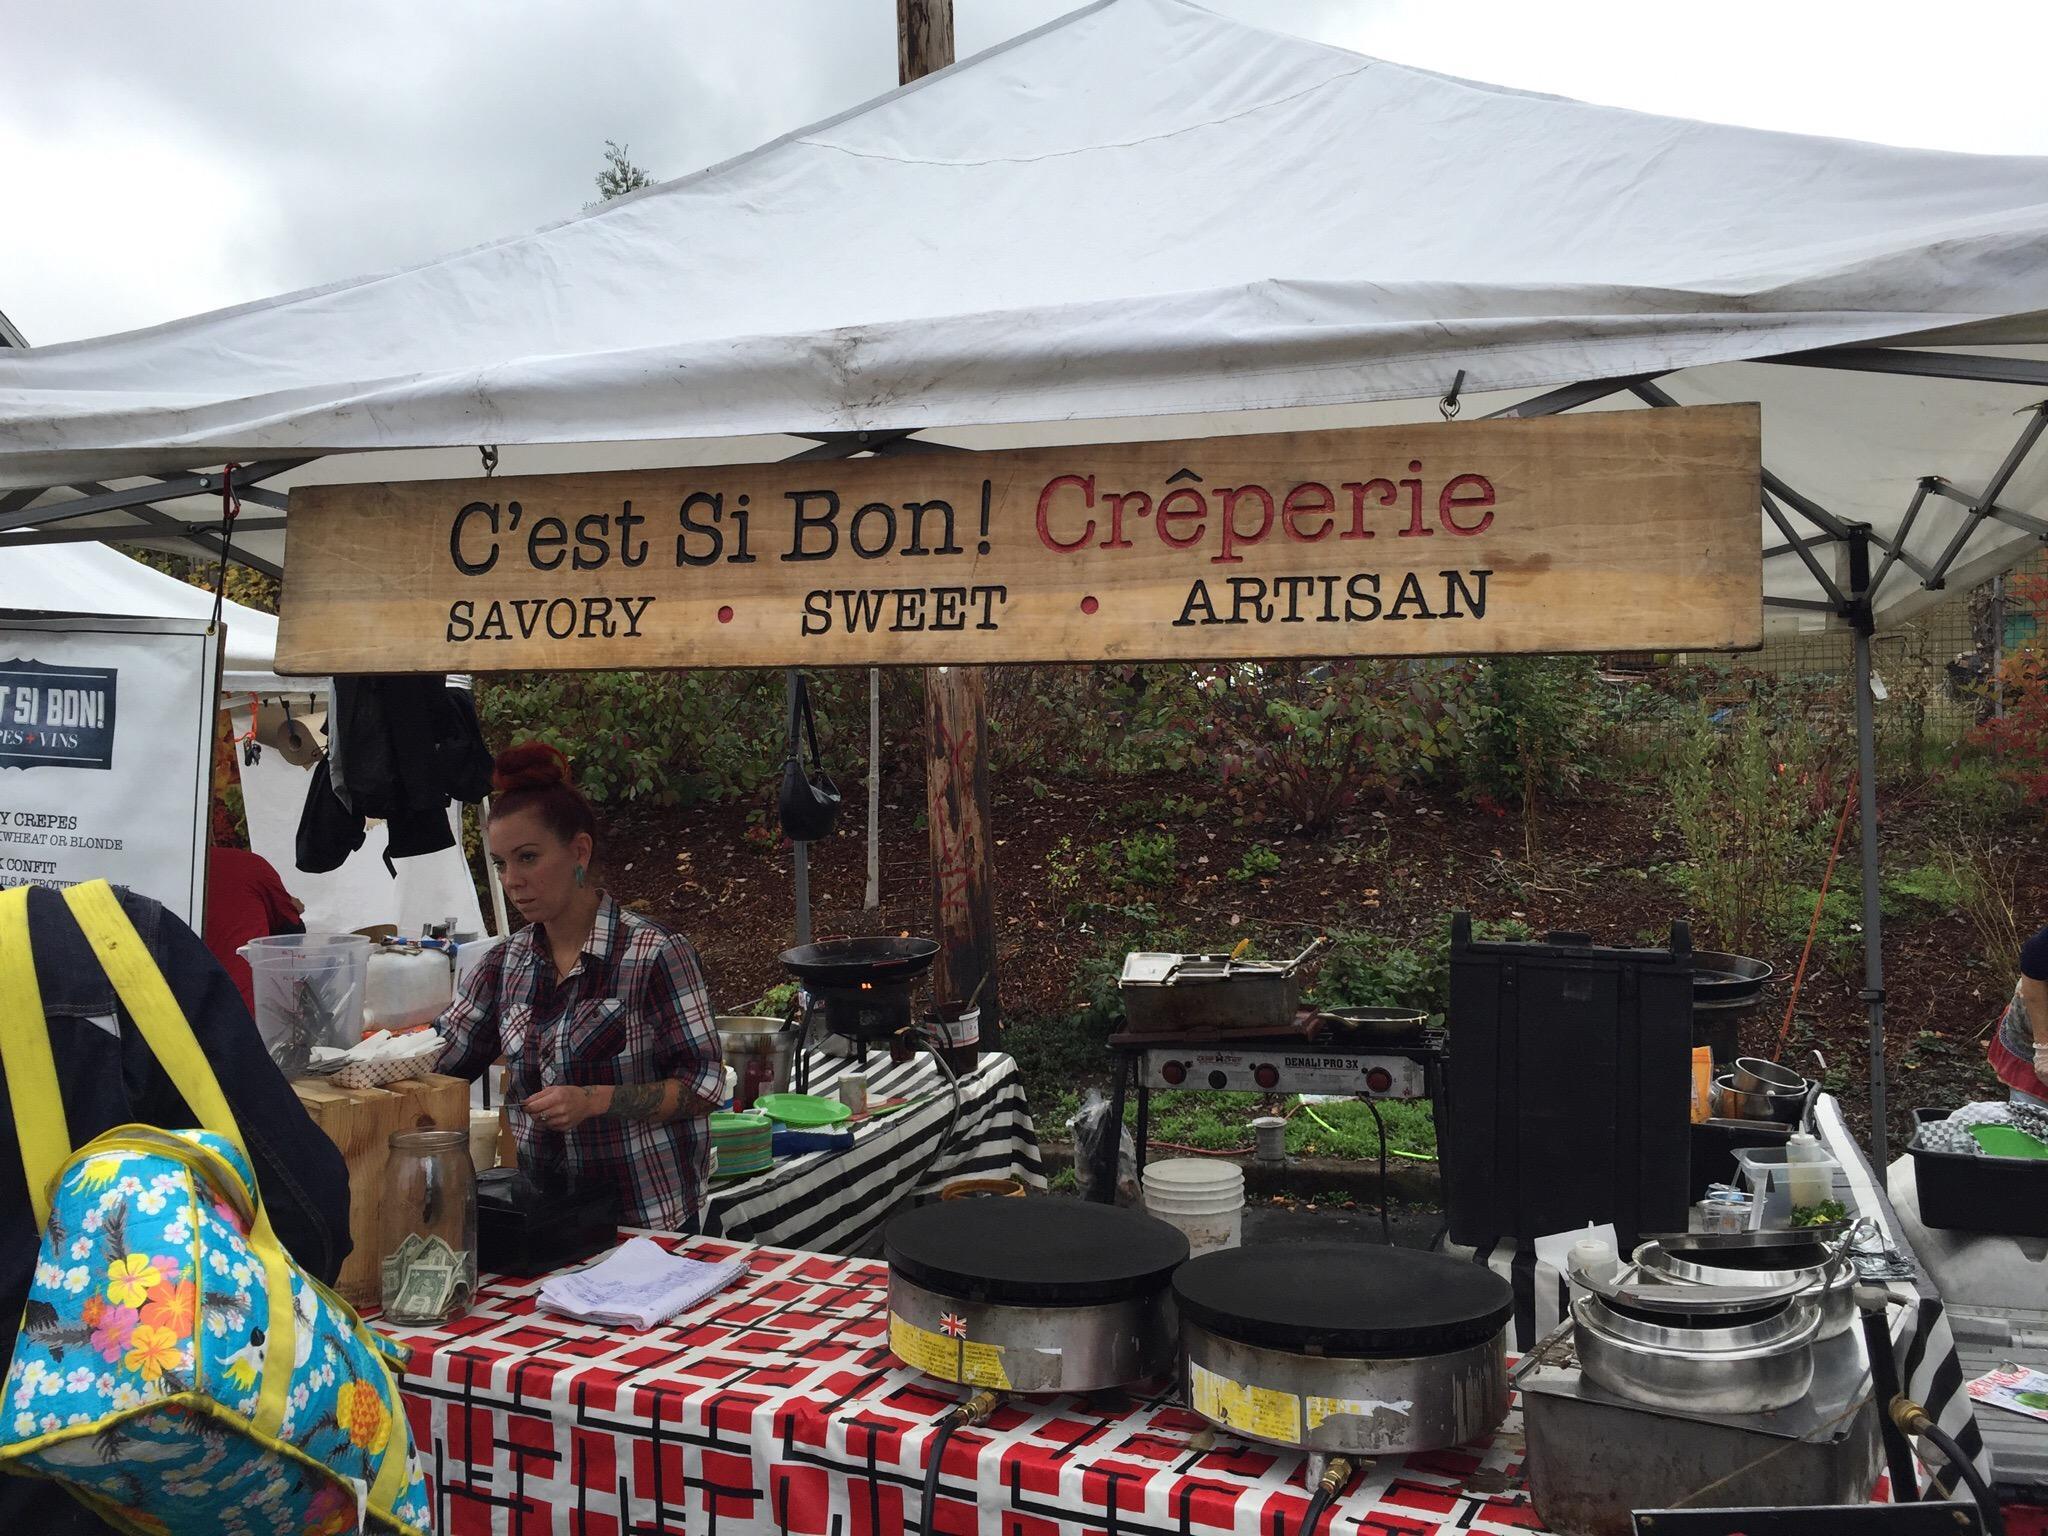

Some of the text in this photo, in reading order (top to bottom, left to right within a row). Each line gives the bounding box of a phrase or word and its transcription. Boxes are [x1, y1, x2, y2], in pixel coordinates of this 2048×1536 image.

[449, 460, 1496, 576] C'est Si Bon! Crêperie
[446, 570, 1493, 643] SAVORY SWEET ARTISAN
[14, 687, 39, 725] SI
[46, 688, 104, 728] BON!
[40, 732, 78, 748] VINS
[14, 812, 77, 830] CREPES
[50, 835, 68, 847] OR
[70, 836, 123, 850] BLONDE
[6, 858, 57, 874] CONFIT
[1284, 1056, 1359, 1069] DENALI PRO 3X
